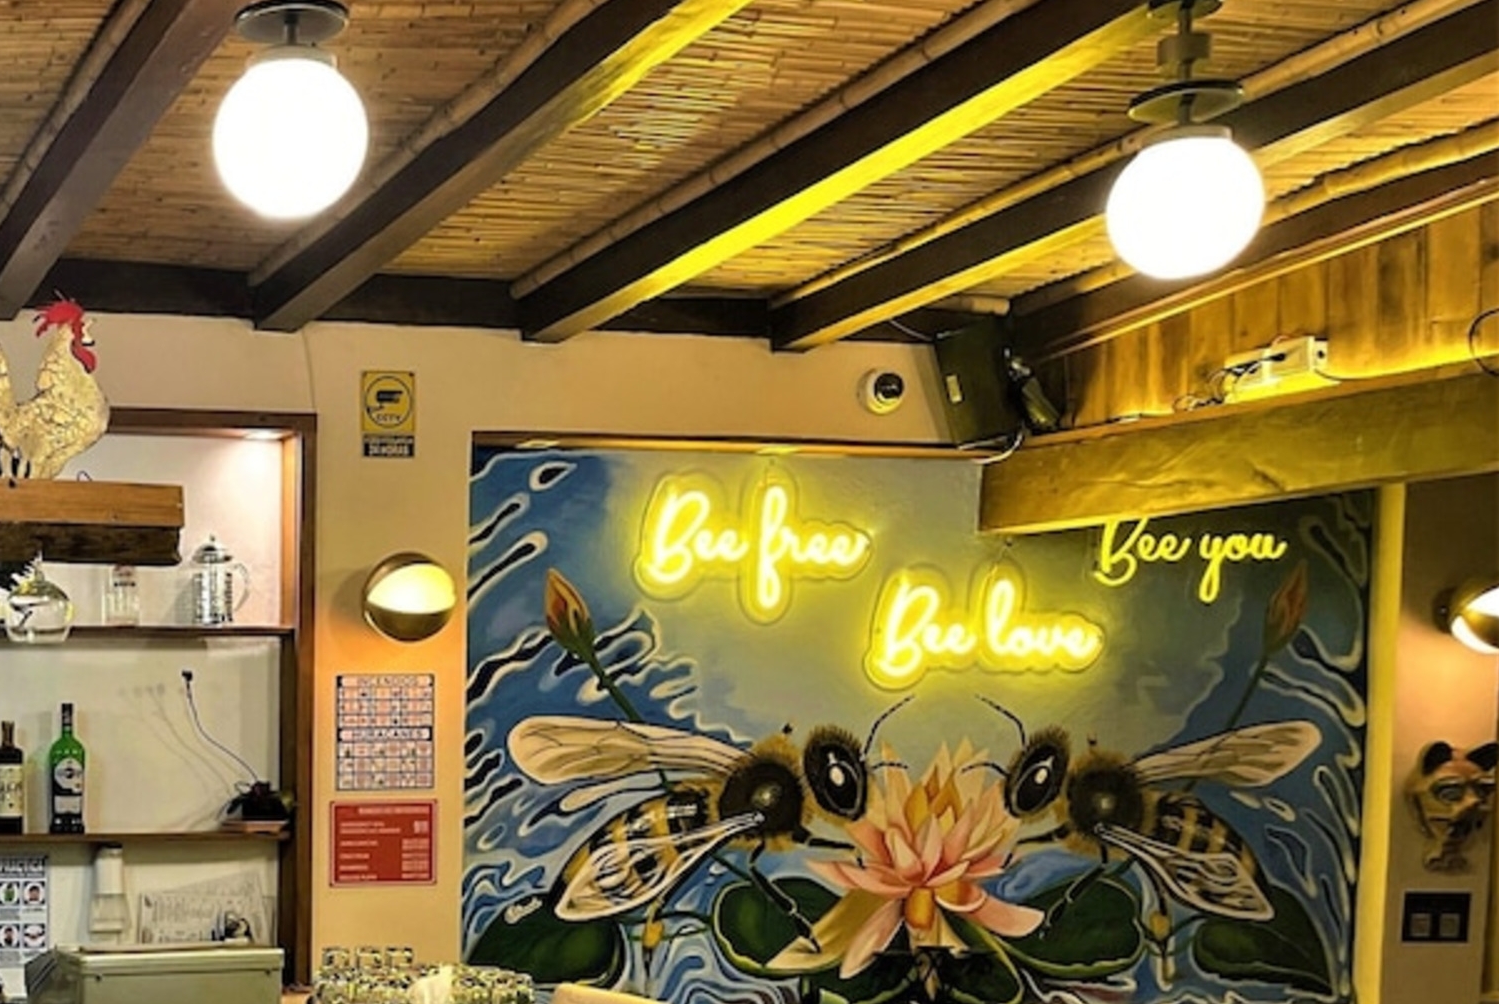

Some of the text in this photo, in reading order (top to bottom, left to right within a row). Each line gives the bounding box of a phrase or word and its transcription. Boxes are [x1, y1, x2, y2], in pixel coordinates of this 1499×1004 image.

[648, 485, 868, 608] Bee free
[1092, 517, 1288, 603] Bee you
[879, 578, 1100, 676] Bee love
